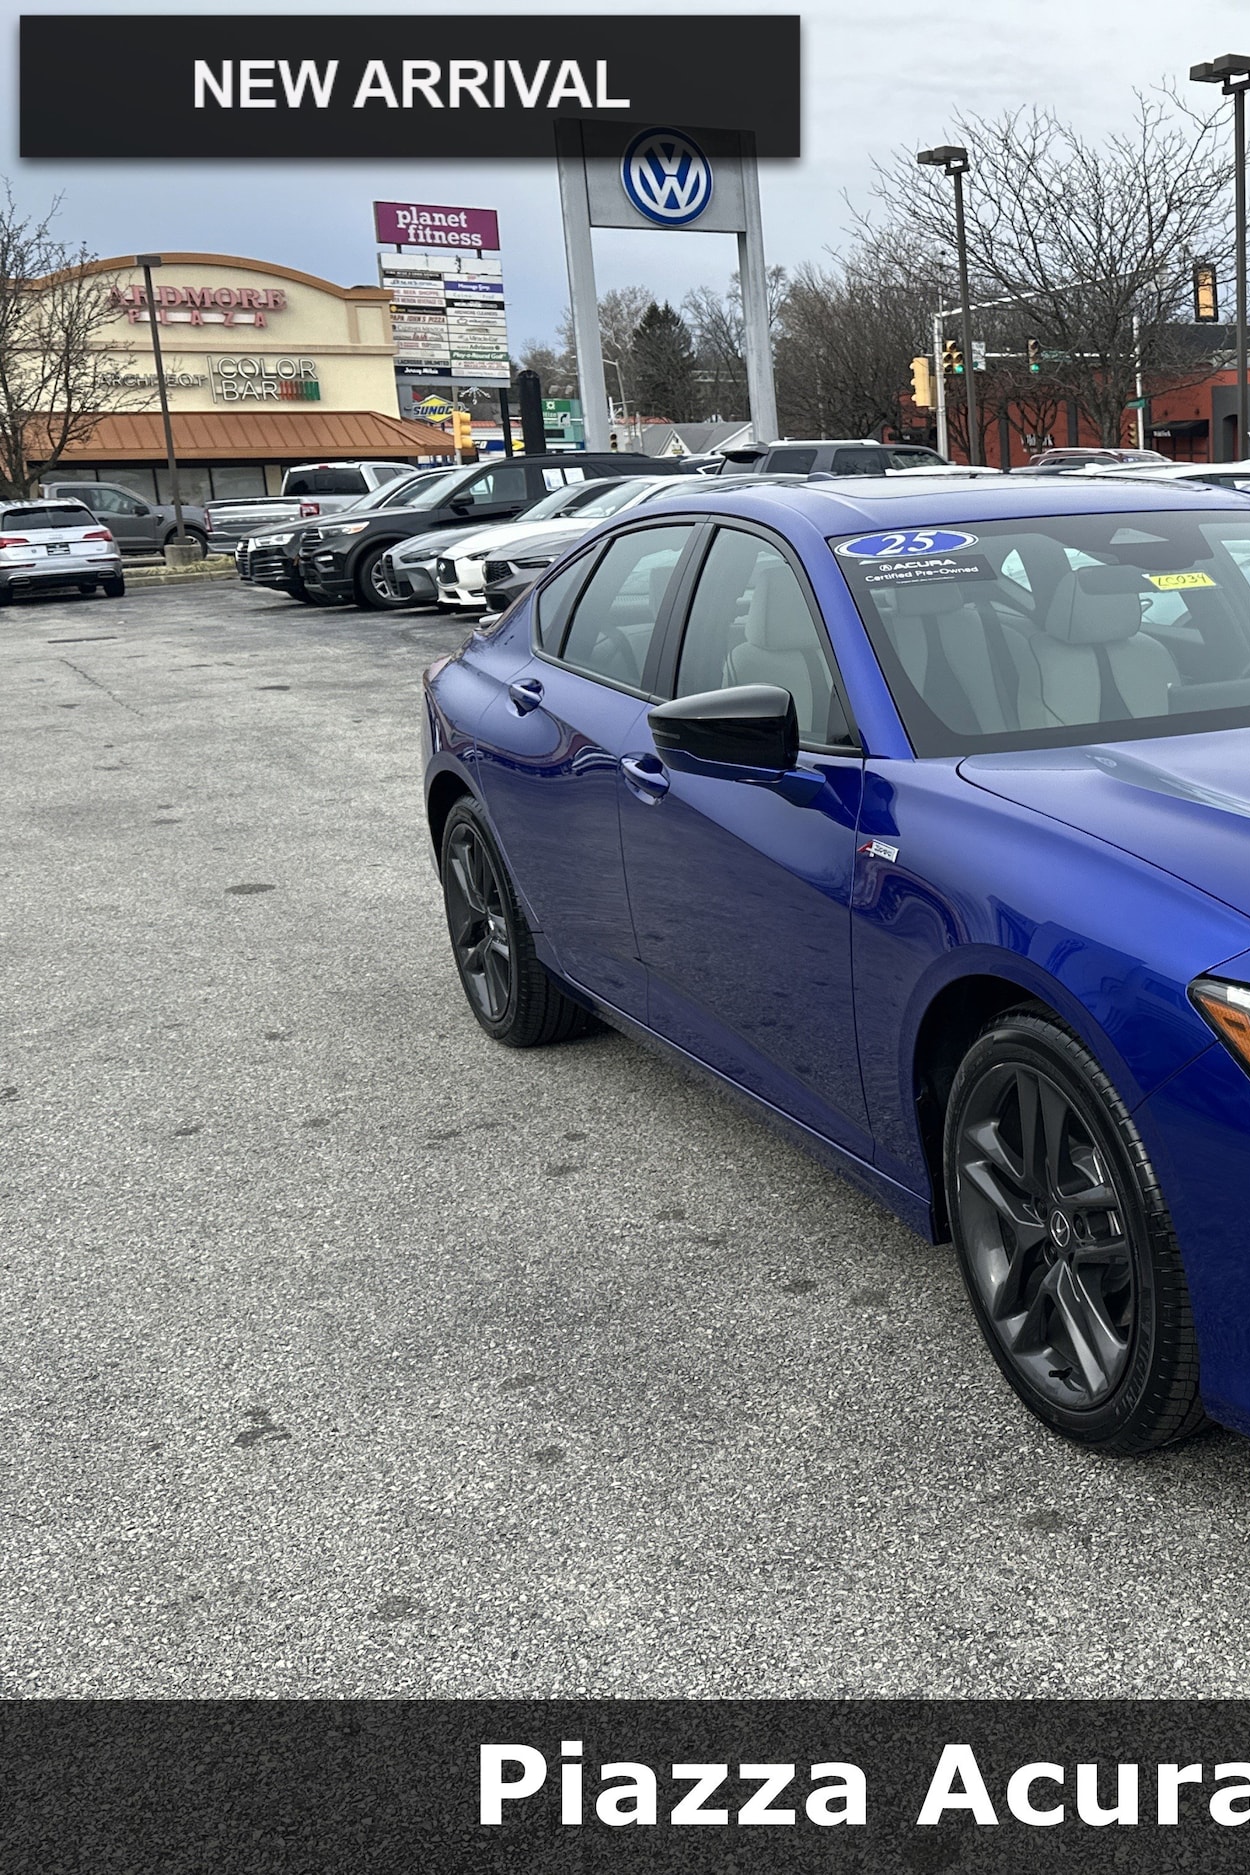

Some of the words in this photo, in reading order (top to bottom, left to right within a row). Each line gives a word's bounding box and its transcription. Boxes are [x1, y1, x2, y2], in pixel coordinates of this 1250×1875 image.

[396, 206, 467, 229] planet
[407, 224, 483, 246] fitness
[109, 285, 288, 311] ARDMORE
[128, 309, 268, 328] PLAZA
[217, 357, 318, 380] COLOR
[221, 380, 280, 401] BAR
[875, 531, 939, 556] 25
[865, 571, 913, 582] Certified
[915, 566, 979, 577] Pre-Owned
[893, 559, 957, 570] ACURA
